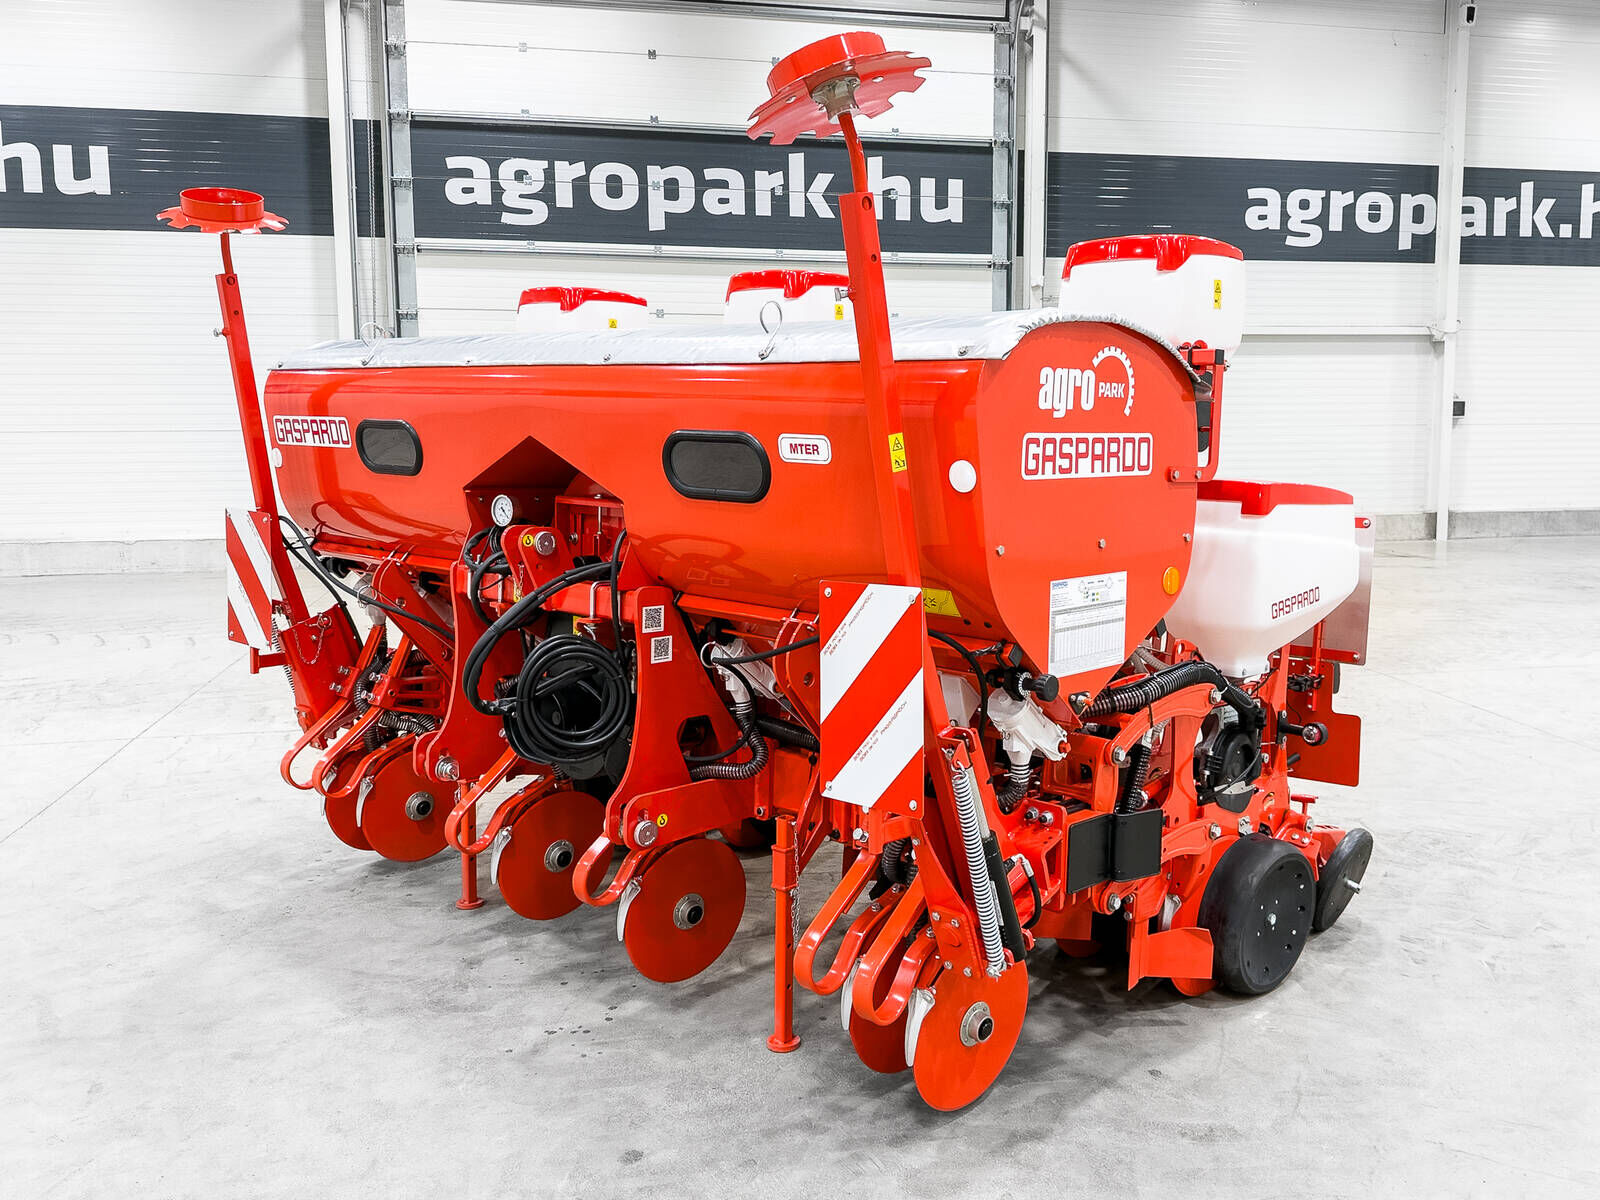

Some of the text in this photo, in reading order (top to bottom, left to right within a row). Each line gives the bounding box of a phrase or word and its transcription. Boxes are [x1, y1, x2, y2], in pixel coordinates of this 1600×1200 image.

[444, 152, 963, 231] agroparkhu
[1038, 366, 1125, 418] agro PARK
[275, 418, 350, 445] GASPARDO
[789, 443, 820, 456] MTER
[1025, 437, 1151, 476] GASPARDO
[1271, 586, 1321, 620] GASPARDO
